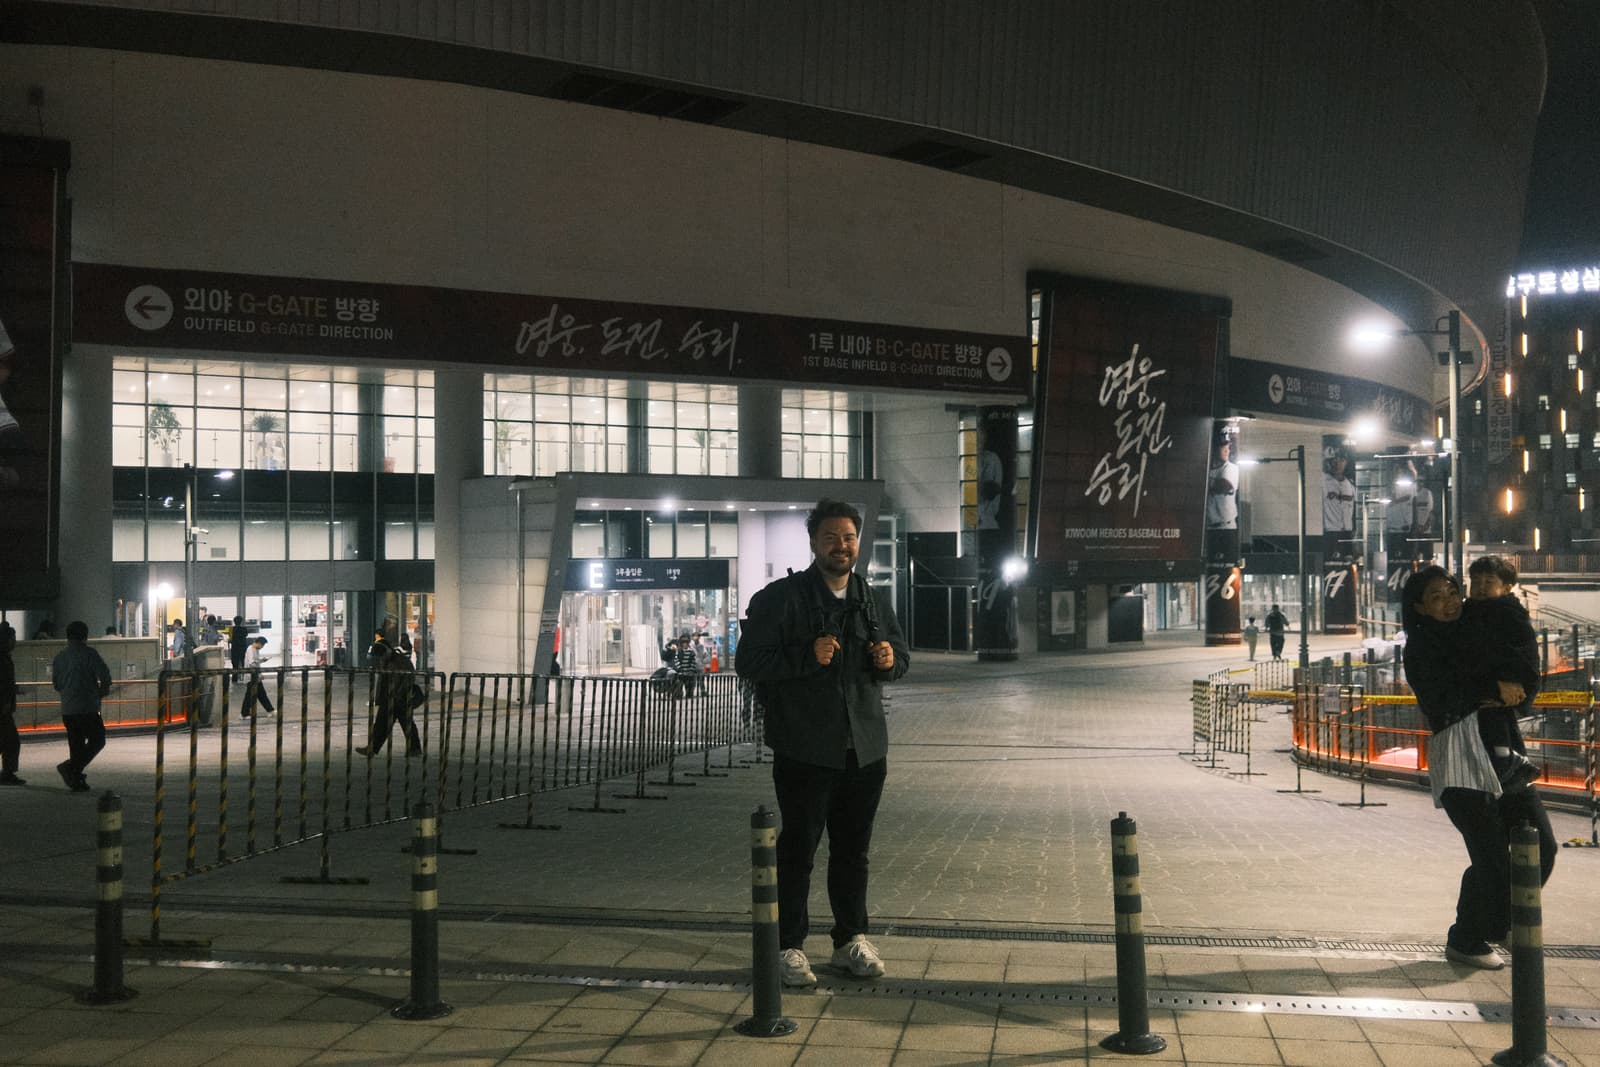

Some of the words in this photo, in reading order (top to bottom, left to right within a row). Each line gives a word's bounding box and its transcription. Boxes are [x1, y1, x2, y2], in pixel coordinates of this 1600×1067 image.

[183, 287, 233, 314] 외야
[238, 293, 328, 319] G-GATE
[334, 296, 380, 323] 방향
[183, 317, 256, 334] OUTFIELD
[260, 321, 315, 337] G-GATE
[319, 324, 394, 342] DIRECTION
[808, 331, 835, 353] 1루
[839, 334, 872, 356] 내야
[954, 343, 983, 365] 방향
[802, 355, 821, 368] 1ST
[823, 357, 849, 369] BASE
[851, 359, 888, 372] INFIELD
[936, 364, 983, 379] DIRECTION
[1064, 527, 1098, 539] KIWOOM
[1098, 527, 1127, 539] HEROES
[1128, 527, 1162, 539] BASEBALL
[1163, 527, 1181, 539] CLUB
[589, 562, 604, 588] E
